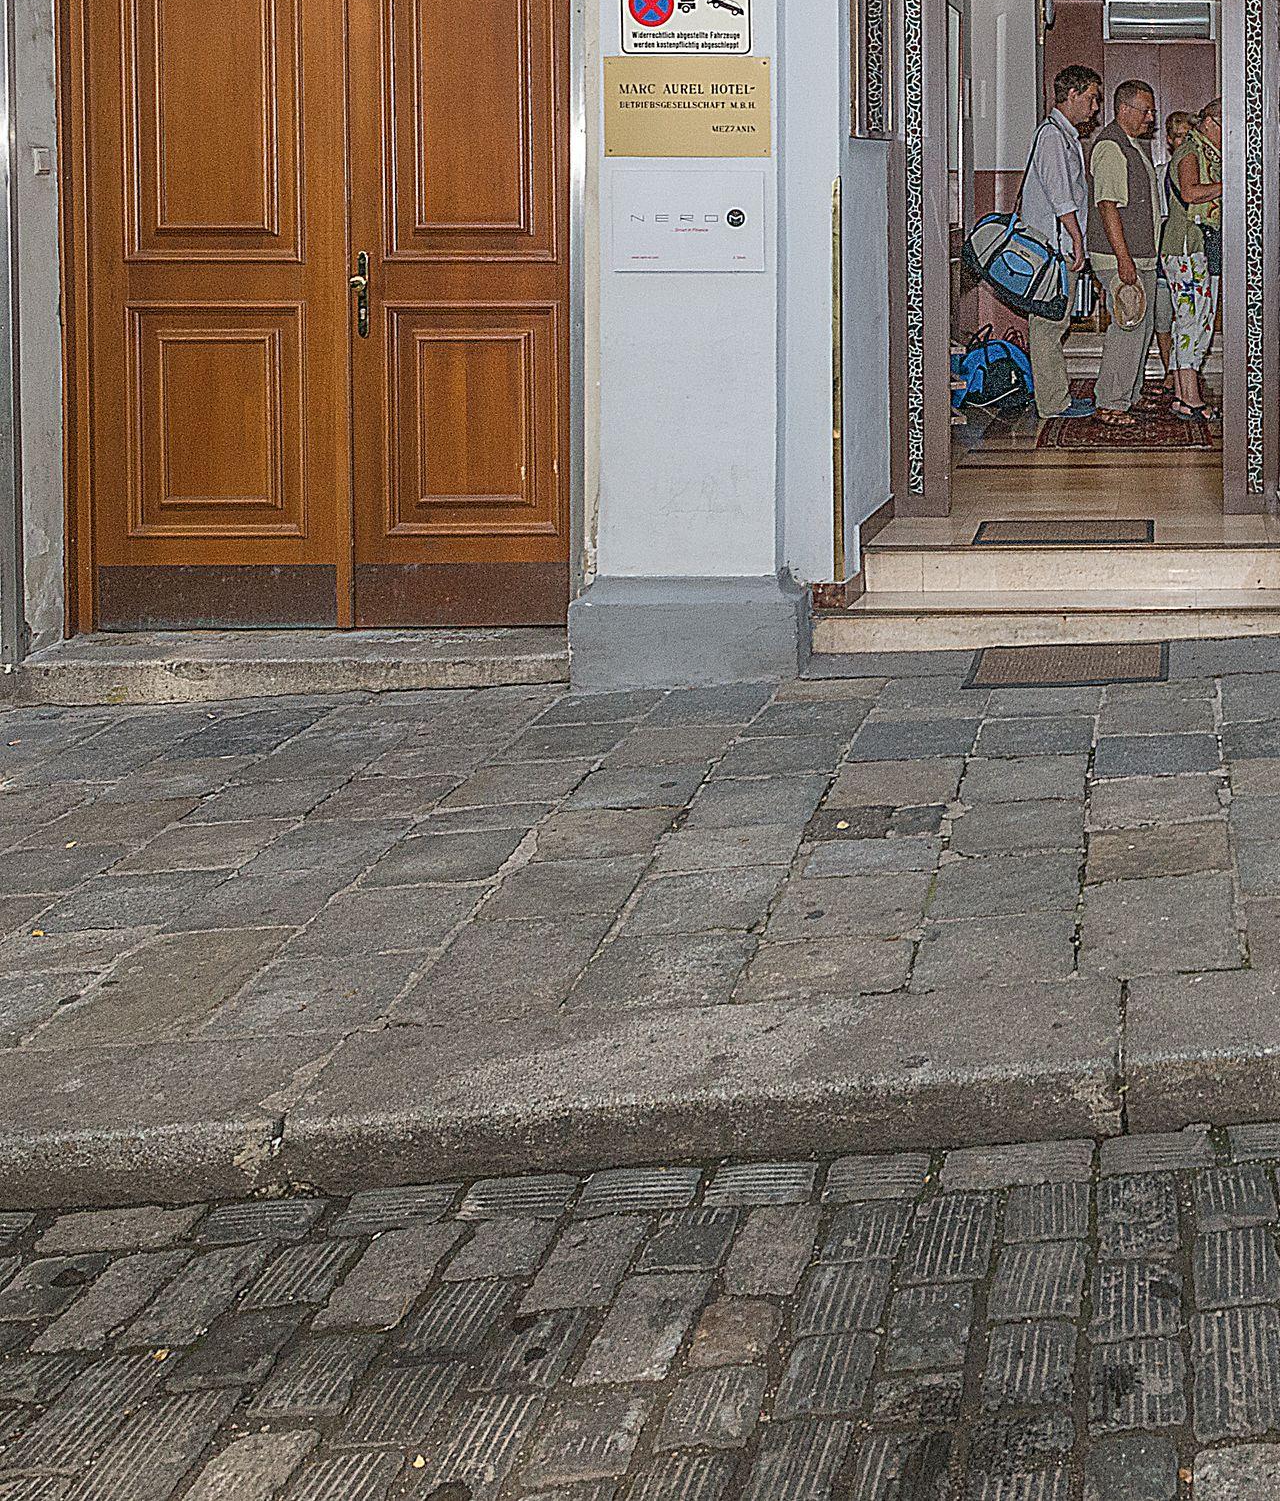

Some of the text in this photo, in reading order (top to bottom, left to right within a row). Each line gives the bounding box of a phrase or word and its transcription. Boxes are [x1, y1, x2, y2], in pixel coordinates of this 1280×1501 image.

[632, 31, 740, 40] Widerrechtlich abgestellte Fahrzeuge
[656, 41, 699, 49] kostenpflichtig
[701, 41, 739, 49] abgeschleppt
[619, 83, 756, 94] MARC AUREL HOTEL-
[619, 101, 725, 109] BETRIEBSGESELLSCHAFT
[711, 125, 756, 133] MEZZANIN
